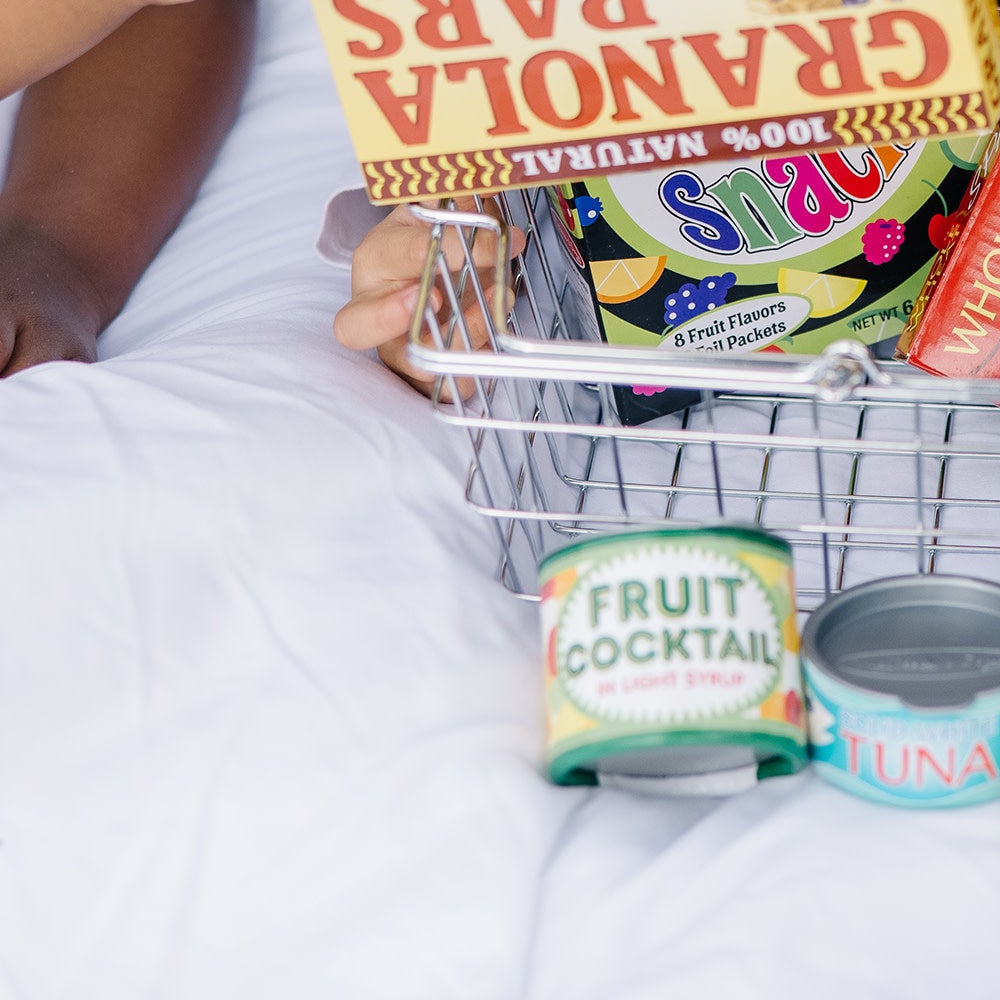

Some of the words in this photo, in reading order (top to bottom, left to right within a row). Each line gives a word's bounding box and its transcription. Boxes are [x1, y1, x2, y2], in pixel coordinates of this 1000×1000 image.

[353, 10, 952, 146] GRANOLA
[510, 130, 709, 177] NATURAL
[720, 115, 833, 153] 100%
[673, 333, 686, 348] 8
[687, 320, 727, 344] Fruit
[727, 300, 788, 331] Flavors
[696, 340, 724, 352] il
[727, 320, 788, 349] Packets
[852, 315, 877, 333] NET
[880, 306, 900, 323] WT
[903, 299, 915, 316] 6
[589, 576, 744, 628] FRUIT
[566, 628, 775, 677] COCKTAIL
[840, 729, 998, 787] TUNA
